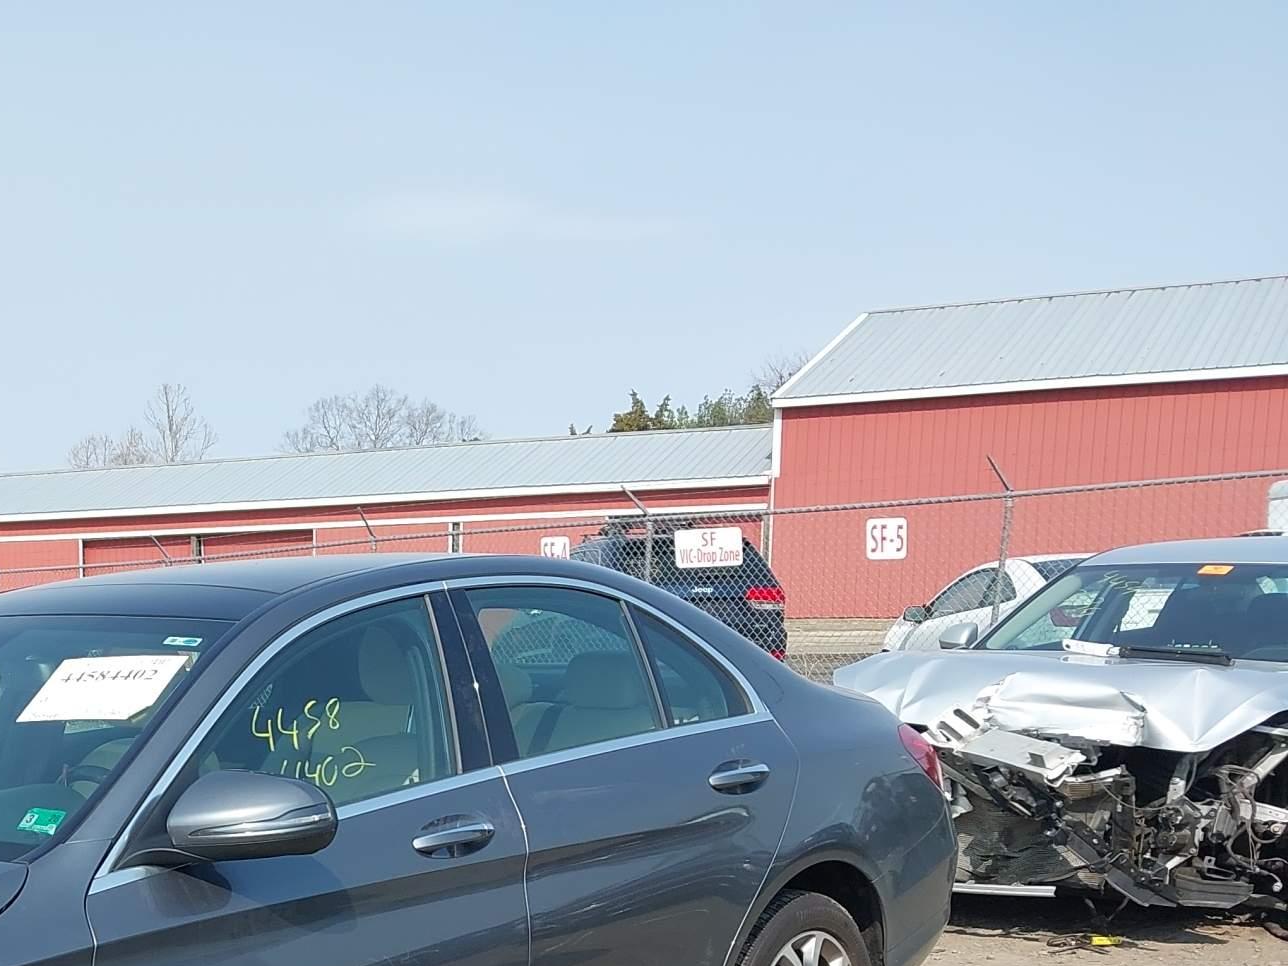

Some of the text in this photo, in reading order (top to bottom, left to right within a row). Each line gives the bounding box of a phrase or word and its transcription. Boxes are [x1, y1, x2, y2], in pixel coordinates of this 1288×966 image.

[701, 531, 716, 547] SF
[870, 524, 904, 552] SF-5
[718, 546, 741, 562] Zone
[691, 585, 714, 594] Jeep
[60, 668, 159, 684] 44584402
[252, 697, 340, 752] 4458
